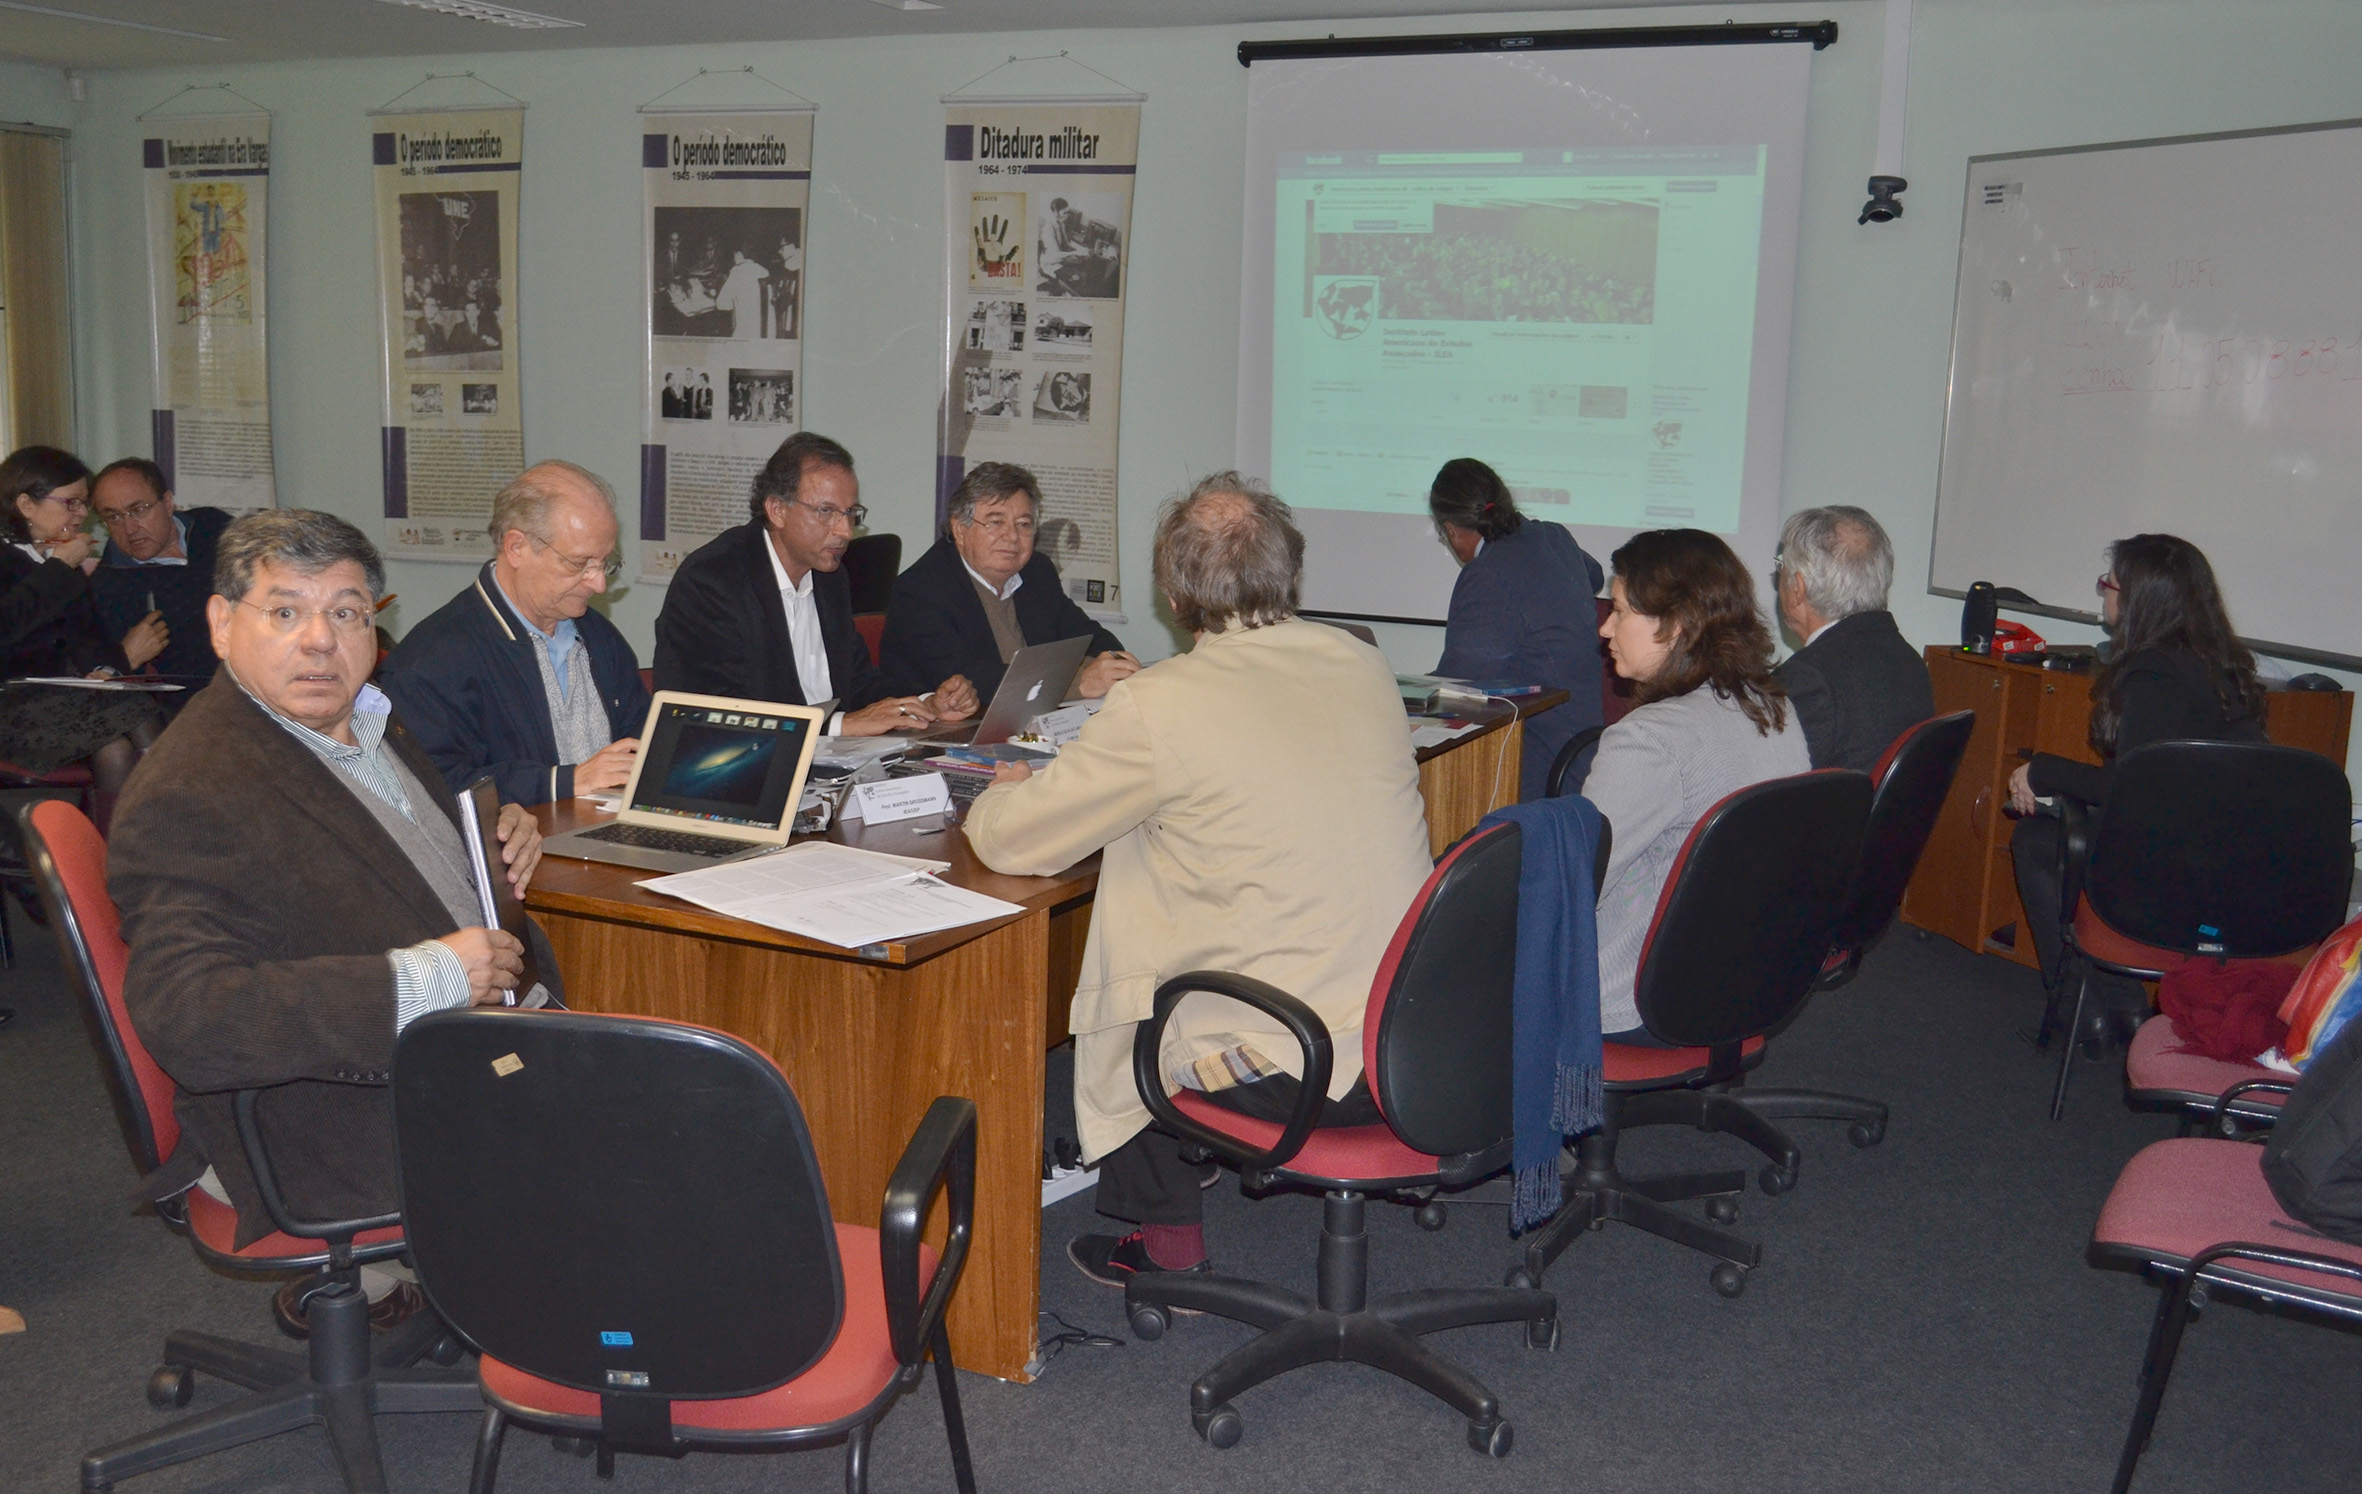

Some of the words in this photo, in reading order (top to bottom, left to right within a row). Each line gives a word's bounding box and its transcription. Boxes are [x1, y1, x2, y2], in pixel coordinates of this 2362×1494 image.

[400, 133, 408, 162] O
[409, 132, 443, 166] período
[445, 129, 503, 160] democrático
[673, 135, 681, 166] O
[683, 135, 720, 171] período
[723, 135, 786, 166] democrático
[980, 126, 1044, 159] Ditadura
[1048, 126, 1100, 159] militar
[672, 172, 690, 181] 1945
[697, 171, 715, 181] 1964
[978, 165, 1000, 175] 1964
[1007, 165, 1028, 175] 1974
[1110, 584, 1119, 601] 7
